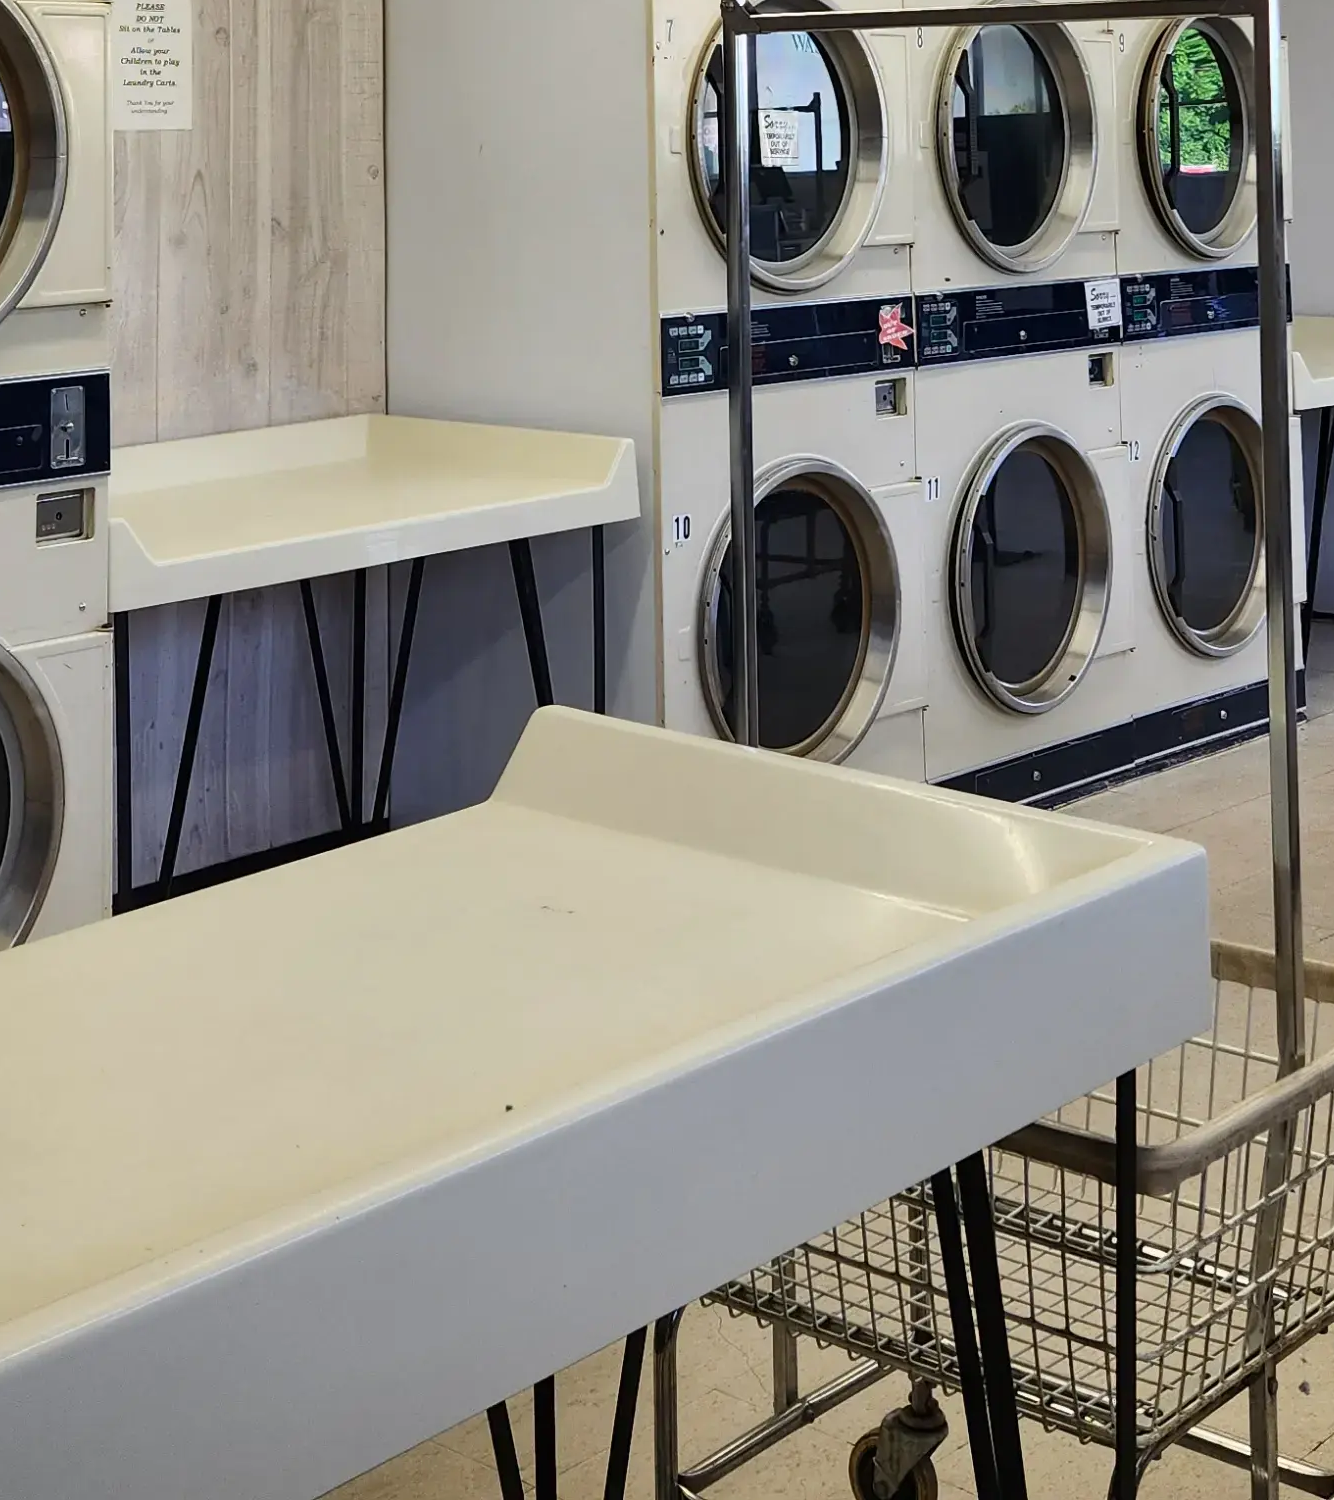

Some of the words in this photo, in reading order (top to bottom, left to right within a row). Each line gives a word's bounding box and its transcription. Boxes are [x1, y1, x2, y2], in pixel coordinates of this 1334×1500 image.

[136, 3, 165, 11] PLEASE
[148, 15, 165, 23] NOT
[666, 19, 674, 43] 7
[917, 27, 923, 48] 8
[153, 48, 170, 56] your
[1119, 33, 1125, 52] 9
[120, 57, 152, 65] Children
[163, 59, 180, 67] play
[123, 79, 154, 87] Laundry
[1128, 440, 1139, 461] 12
[927, 477, 938, 500] 11
[674, 515, 690, 540] 10
